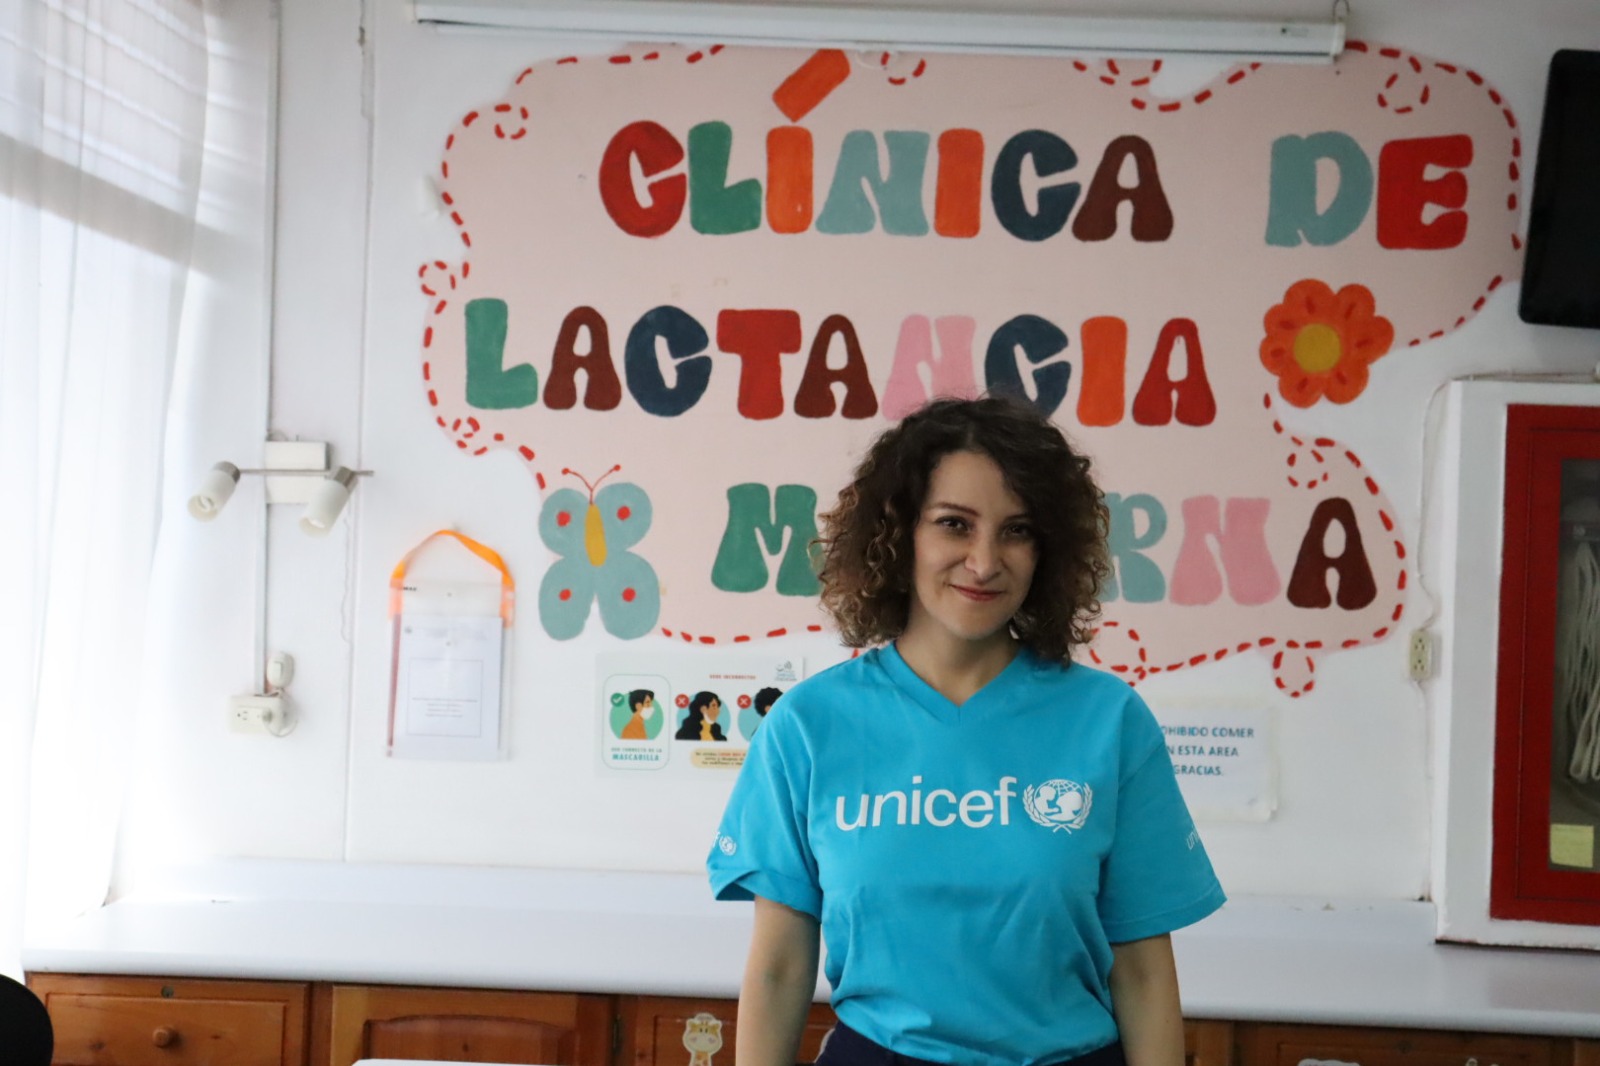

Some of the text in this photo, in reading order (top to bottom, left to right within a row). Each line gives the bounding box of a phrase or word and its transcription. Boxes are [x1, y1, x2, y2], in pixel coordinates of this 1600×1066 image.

[599, 49, 1473, 250] CLÍNICA DE
[465, 298, 1216, 427] LACTANCIA
[711, 483, 1377, 610] MRNA
[1161, 726, 1254, 738] OHIBIDO COMER
[1167, 745, 1239, 757] N ESTA AREA
[836, 775, 1017, 832] unicef
